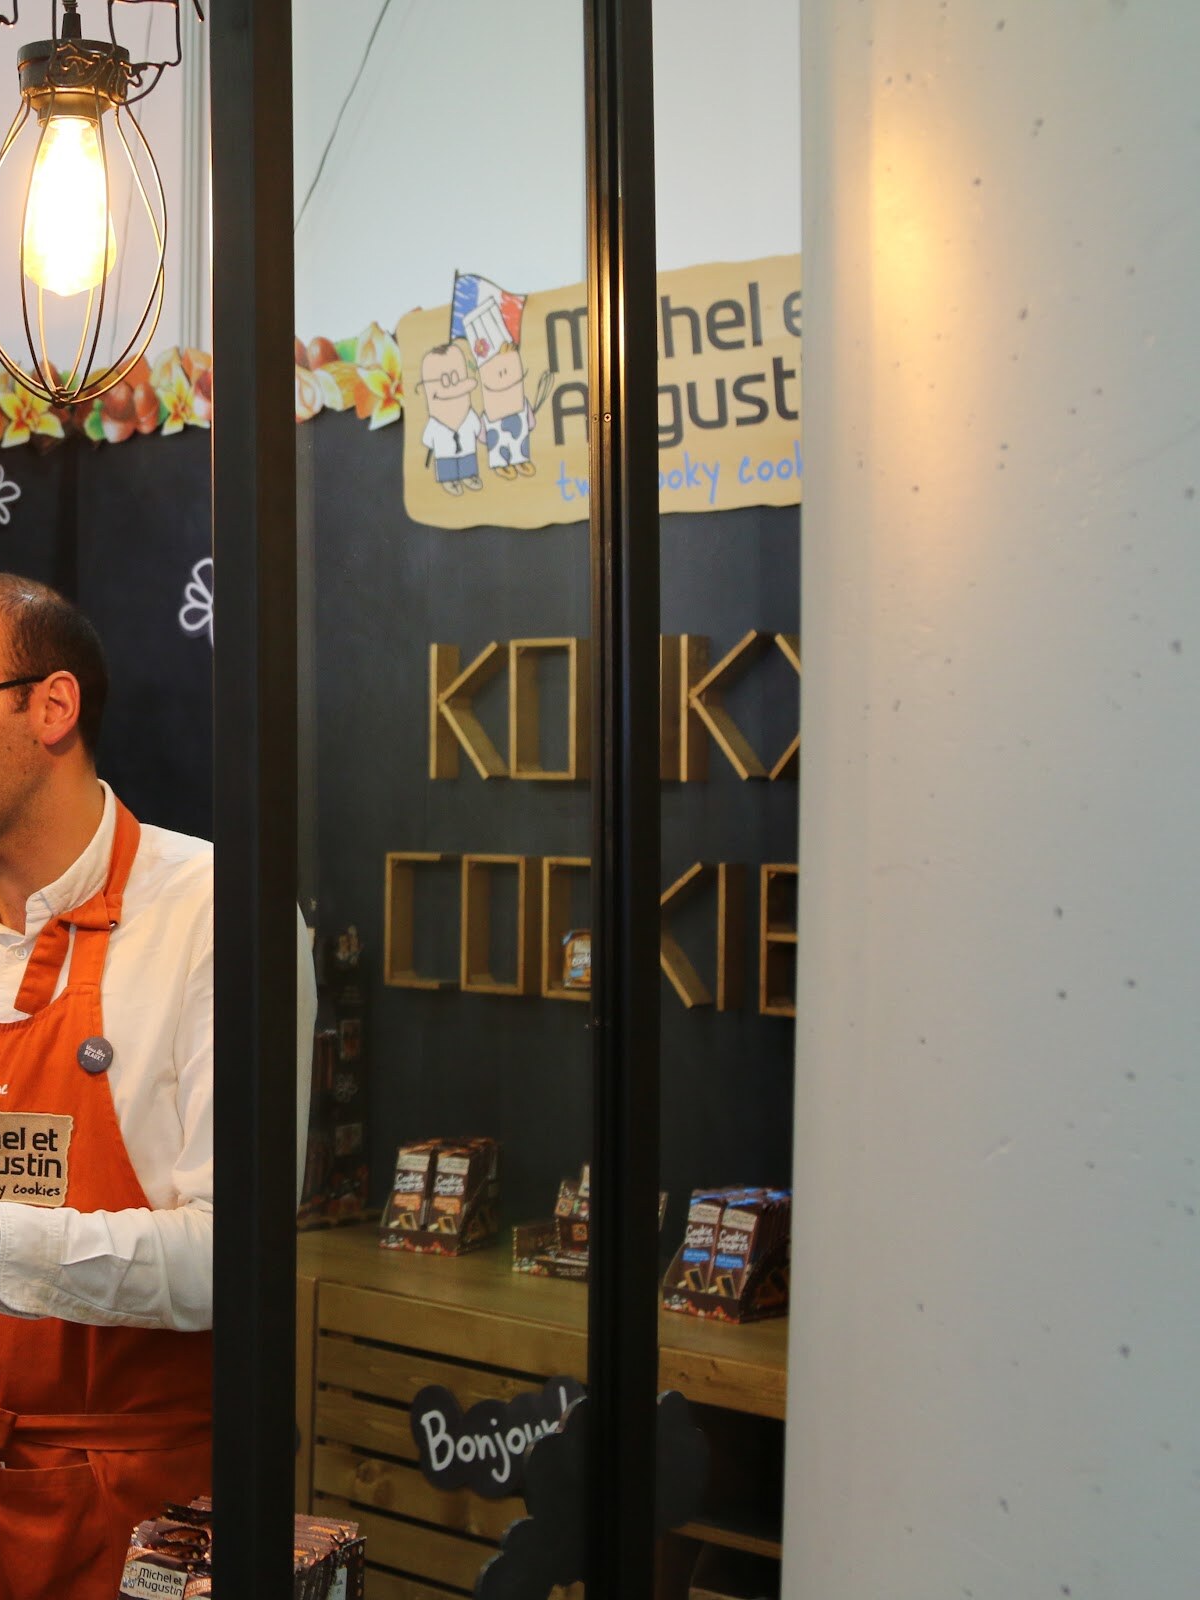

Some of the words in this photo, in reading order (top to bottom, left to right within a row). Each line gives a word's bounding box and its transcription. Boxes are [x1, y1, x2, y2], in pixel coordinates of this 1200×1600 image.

[31, 1128, 59, 1152] et
[12, 1181, 61, 1197] cookies
[139, 1566, 172, 1583] Michel
[173, 1576, 183, 1587] et
[137, 1577, 183, 1597] Augustin
